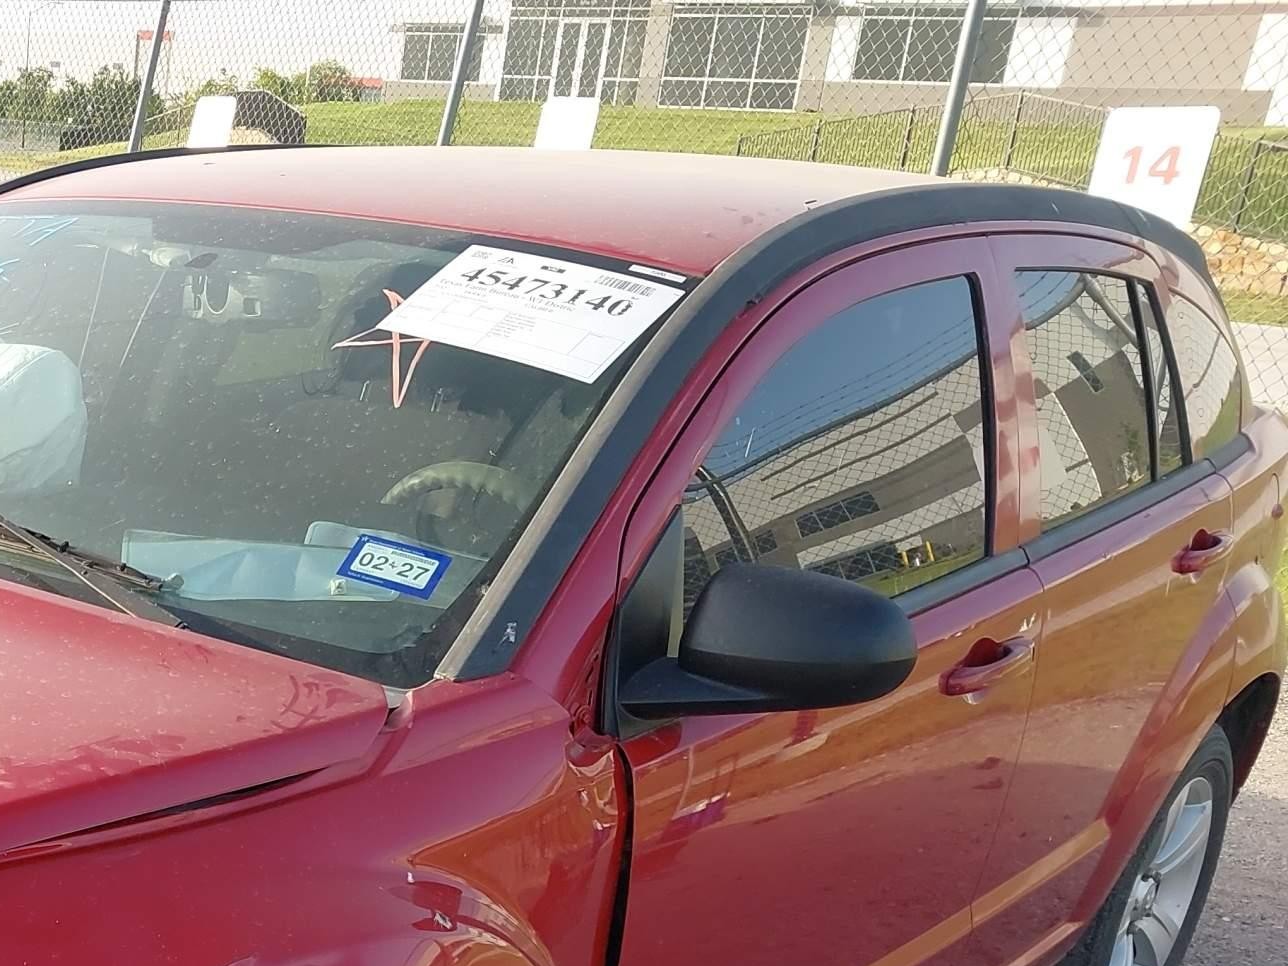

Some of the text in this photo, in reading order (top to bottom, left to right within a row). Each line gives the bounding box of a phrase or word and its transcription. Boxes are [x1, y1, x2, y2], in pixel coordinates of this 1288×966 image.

[1122, 145, 1183, 185] 14
[460, 267, 633, 317] 45473140
[358, 552, 389, 571] 02
[396, 562, 431, 581] 27
